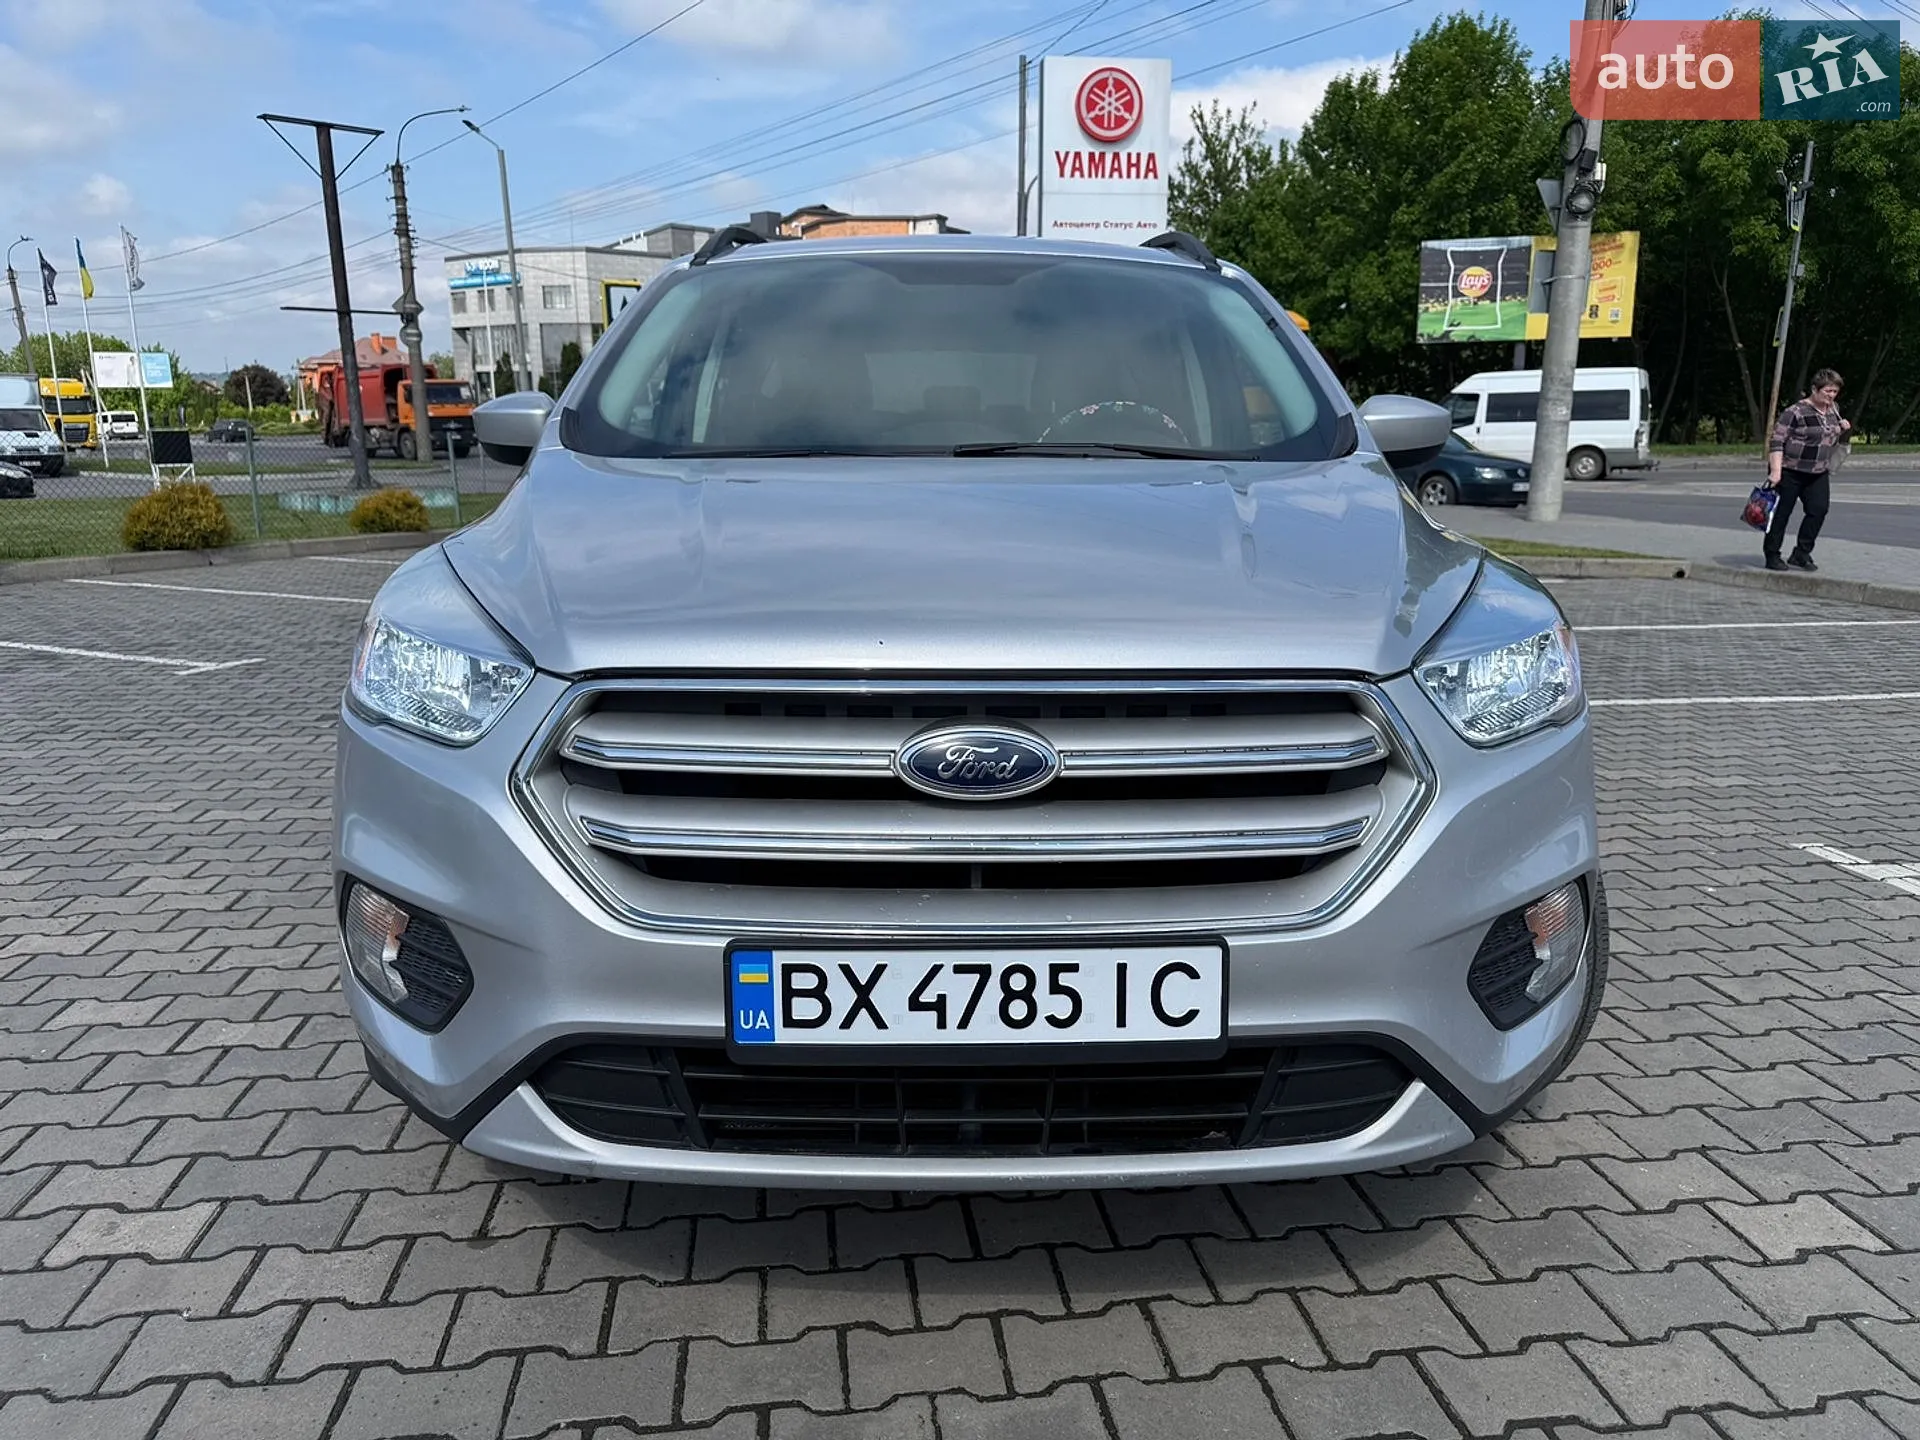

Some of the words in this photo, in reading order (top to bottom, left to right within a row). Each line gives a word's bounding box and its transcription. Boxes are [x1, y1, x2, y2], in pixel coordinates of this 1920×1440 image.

[1054, 150, 1159, 180] YAMAHA
[1052, 220, 1100, 230] Автоцентр
[1102, 220, 1134, 230] Статус
[1136, 220, 1158, 229] Авто
[937, 745, 1020, 780] Ford
[781, 962, 889, 1030] BX
[907, 962, 1083, 1030] 4785
[739, 1010, 771, 1030] UA
